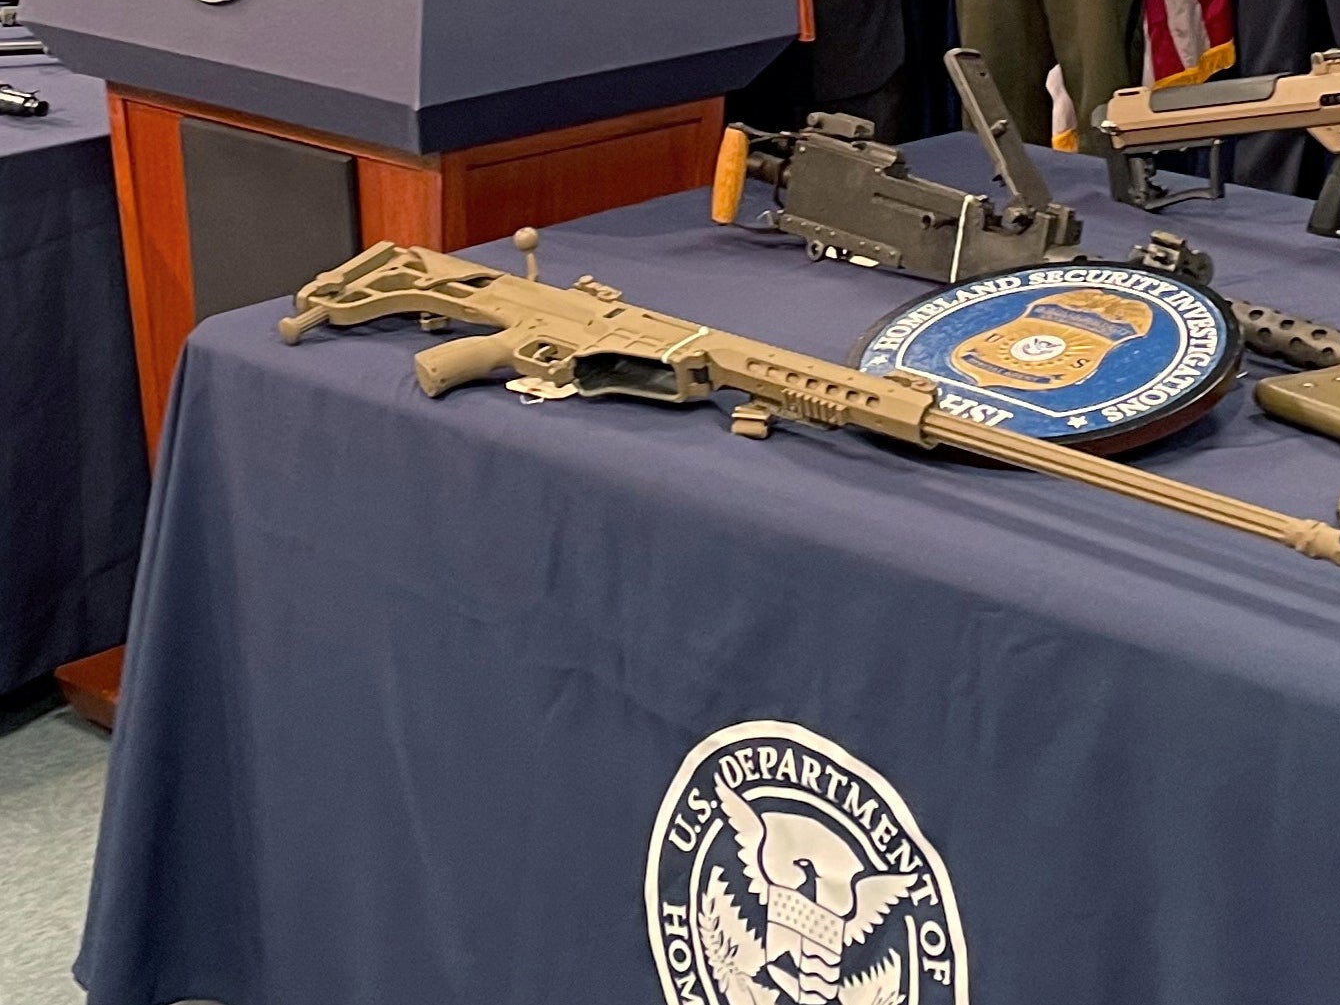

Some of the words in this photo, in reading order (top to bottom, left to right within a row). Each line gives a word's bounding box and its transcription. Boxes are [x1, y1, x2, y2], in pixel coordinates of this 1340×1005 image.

[873, 275, 1023, 353] HOMELAND
[1029, 268, 1173, 303] SECURITY
[1105, 289, 1218, 424] INVESTIGATIONS
[668, 788, 718, 852] U.S.
[718, 746, 938, 907] DEPARTMENT
[919, 920, 951, 986] OF
[662, 901, 706, 1005] HOM
